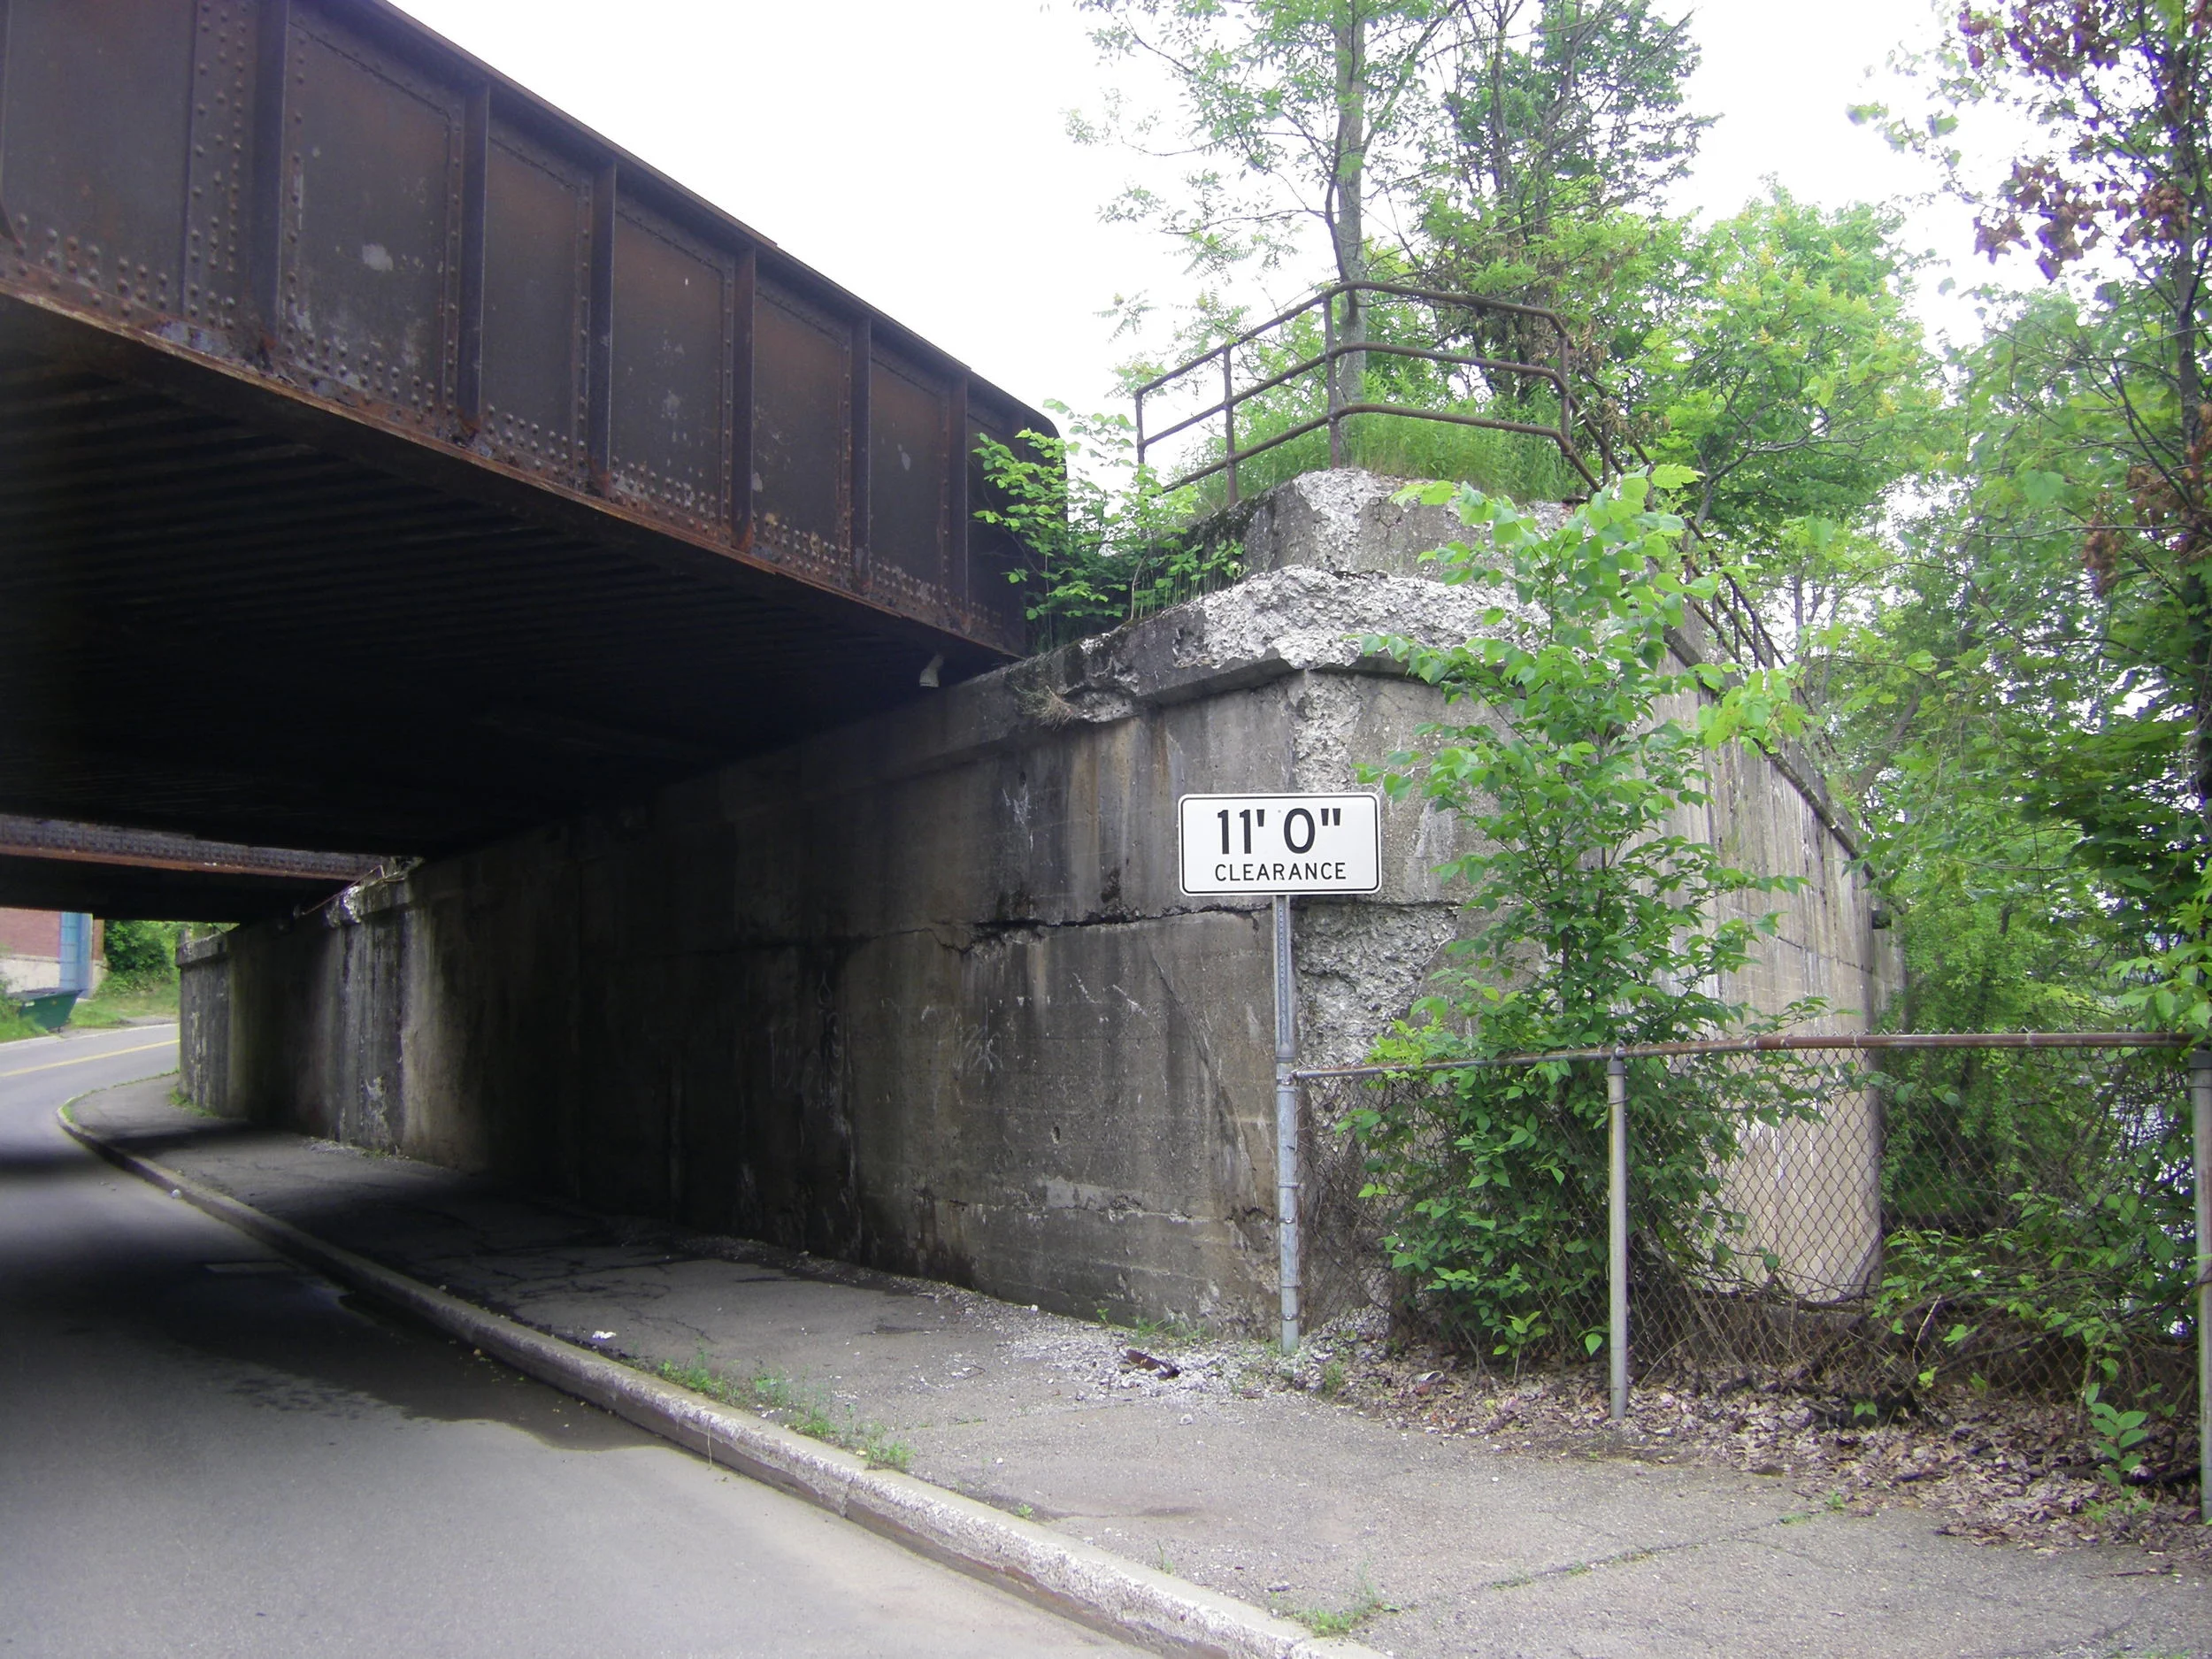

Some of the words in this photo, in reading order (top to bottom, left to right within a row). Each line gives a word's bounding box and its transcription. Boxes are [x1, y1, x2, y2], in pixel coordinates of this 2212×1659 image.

[1217, 809, 1265, 855] 11'
[1284, 808, 1341, 854] 0"
[1215, 863, 1347, 882] CLEARANCE
